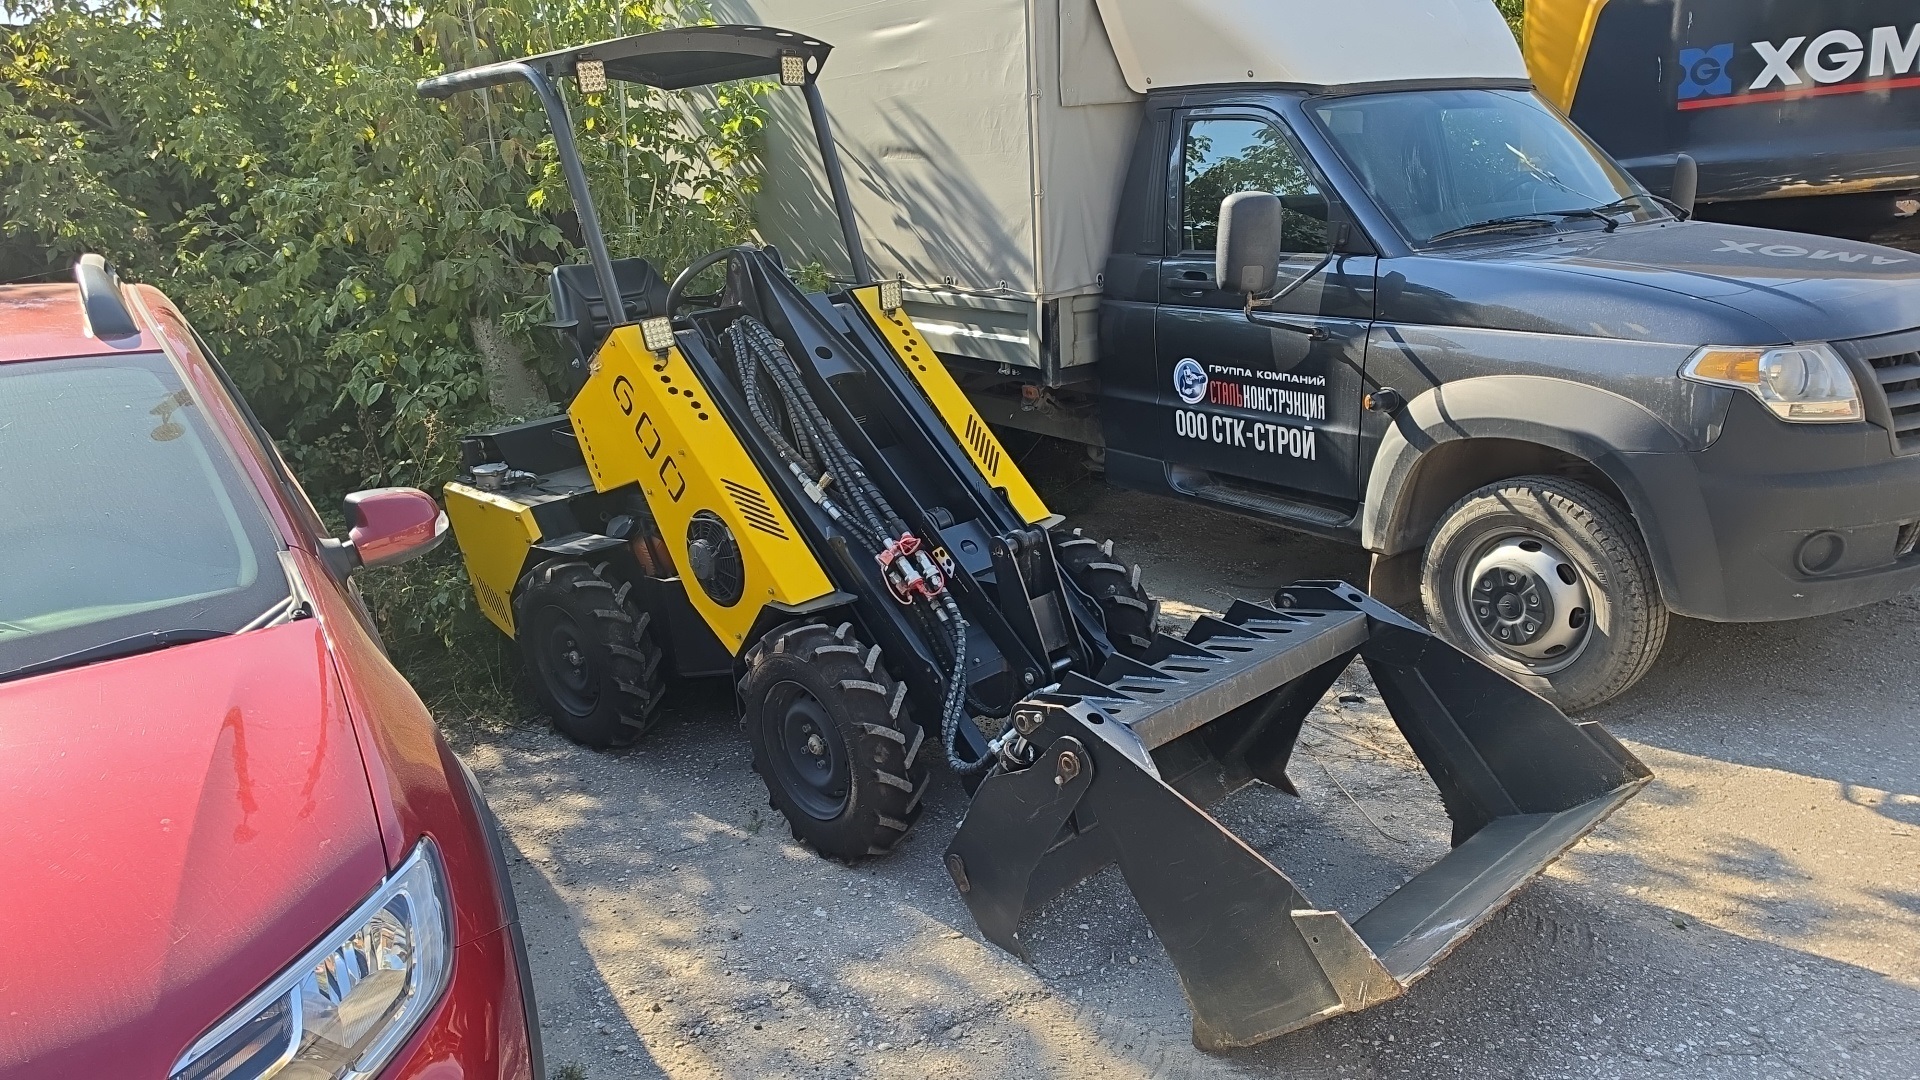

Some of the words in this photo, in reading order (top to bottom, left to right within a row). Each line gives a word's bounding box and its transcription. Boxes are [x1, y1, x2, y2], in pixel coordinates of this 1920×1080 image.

[1208, 364, 1253, 378] ГРУППА
[1256, 370, 1326, 387] КОМПАНИЙ
[612, 375, 686, 503] 600
[1211, 415, 1316, 461] СТК-СТРОЙ
